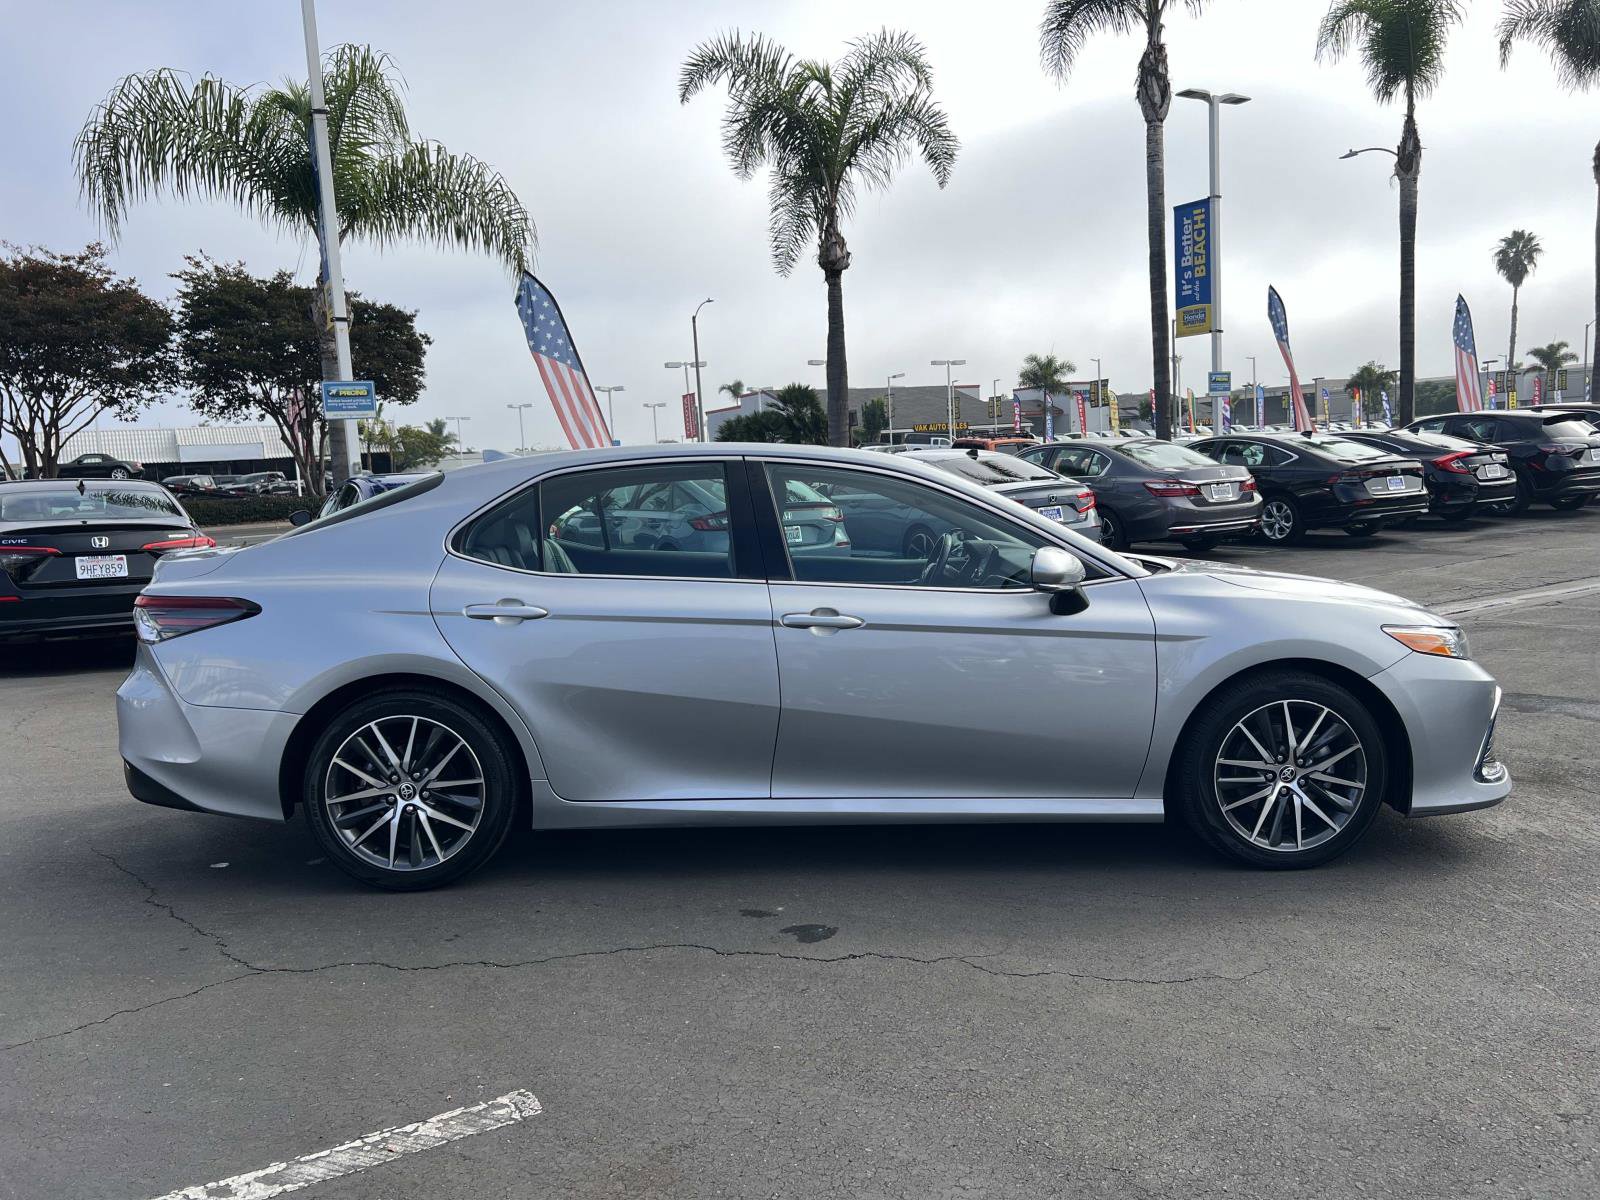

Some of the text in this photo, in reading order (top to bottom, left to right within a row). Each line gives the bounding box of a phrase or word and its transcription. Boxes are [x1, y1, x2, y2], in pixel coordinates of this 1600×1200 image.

[1181, 217, 1193, 296] It's Better
[1192, 207, 1206, 278] BEACH!
[914, 422, 967, 432] VAK AUTO LES
[80, 563, 123, 575] 9HFY859
